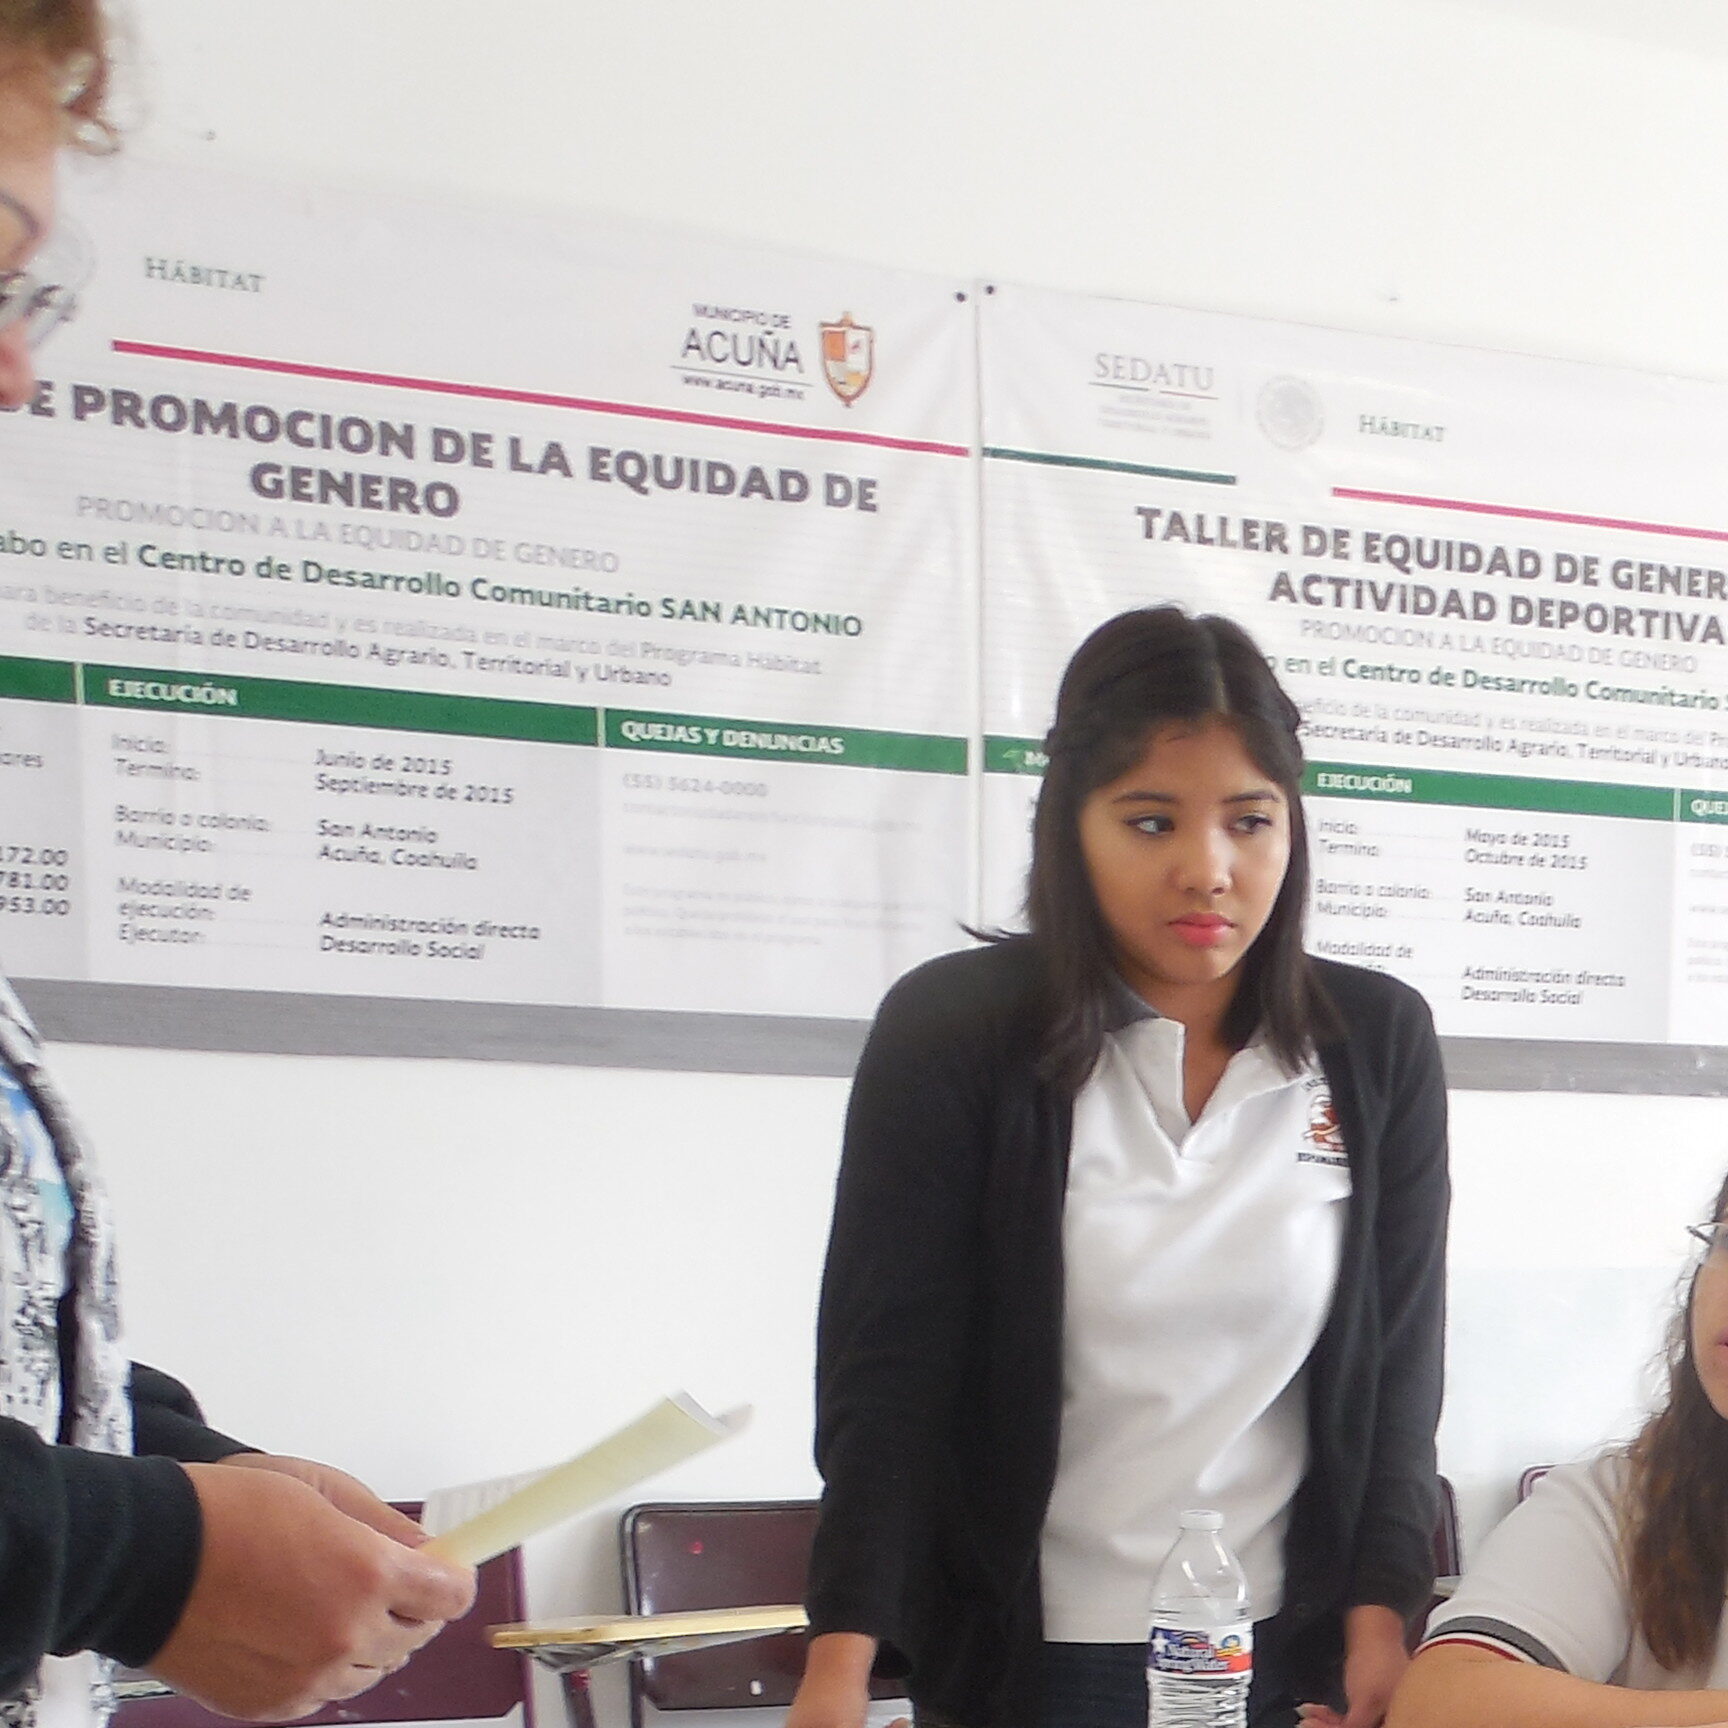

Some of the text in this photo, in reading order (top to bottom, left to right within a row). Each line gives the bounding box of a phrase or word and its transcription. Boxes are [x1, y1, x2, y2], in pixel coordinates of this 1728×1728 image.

[681, 327, 804, 373] ACUÑA
[1094, 352, 1215, 391] SEDATU
[0, 380, 879, 512] E PROMOCION DE LA EQUIDAD DE
[250, 462, 460, 518] GENERO
[76, 495, 620, 576] PROMOCION A LA EQUIDAD DE GENERO
[1135, 505, 1289, 555] TALLER
[1302, 524, 1351, 561] DE
[1363, 531, 1542, 580] EQUIDAD
[1554, 552, 1599, 587] DE
[57, 541, 94, 561] en
[102, 541, 128, 566] el
[138, 544, 246, 578] Centro
[255, 555, 292, 582] de
[303, 559, 460, 599] Desarrollo
[470, 576, 652, 617] Comunitario
[661, 597, 722, 624] SAN
[730, 603, 864, 638] ANTONIO
[1269, 570, 1728, 646] ACTIVIDAD DEPORTIVA
[211, 627, 236, 650] de
[244, 631, 360, 660] Desarrollo
[462, 651, 570, 678] Territorial
[575, 664, 587, 684] y
[595, 665, 672, 687] Urbano
[1301, 619, 1698, 674] PROMOCION A LA EQUIDAD DE GENERO
[1285, 656, 1311, 674] en
[1343, 658, 1421, 684] Centro
[1428, 665, 1455, 687] de
[1462, 668, 1578, 699] Desarrollo
[1586, 679, 1719, 711] Comunitario
[315, 749, 453, 775] Junio de 2015
[621, 720, 845, 755] QUEJAS Y DENUNCIAS
[1417, 730, 1502, 753] Desarrollo
[315, 773, 515, 805] Septiembre de 2015
[317, 819, 439, 844] San Antonio
[390, 848, 478, 871] Coahuila
[320, 934, 486, 961] Desarrollo Social
